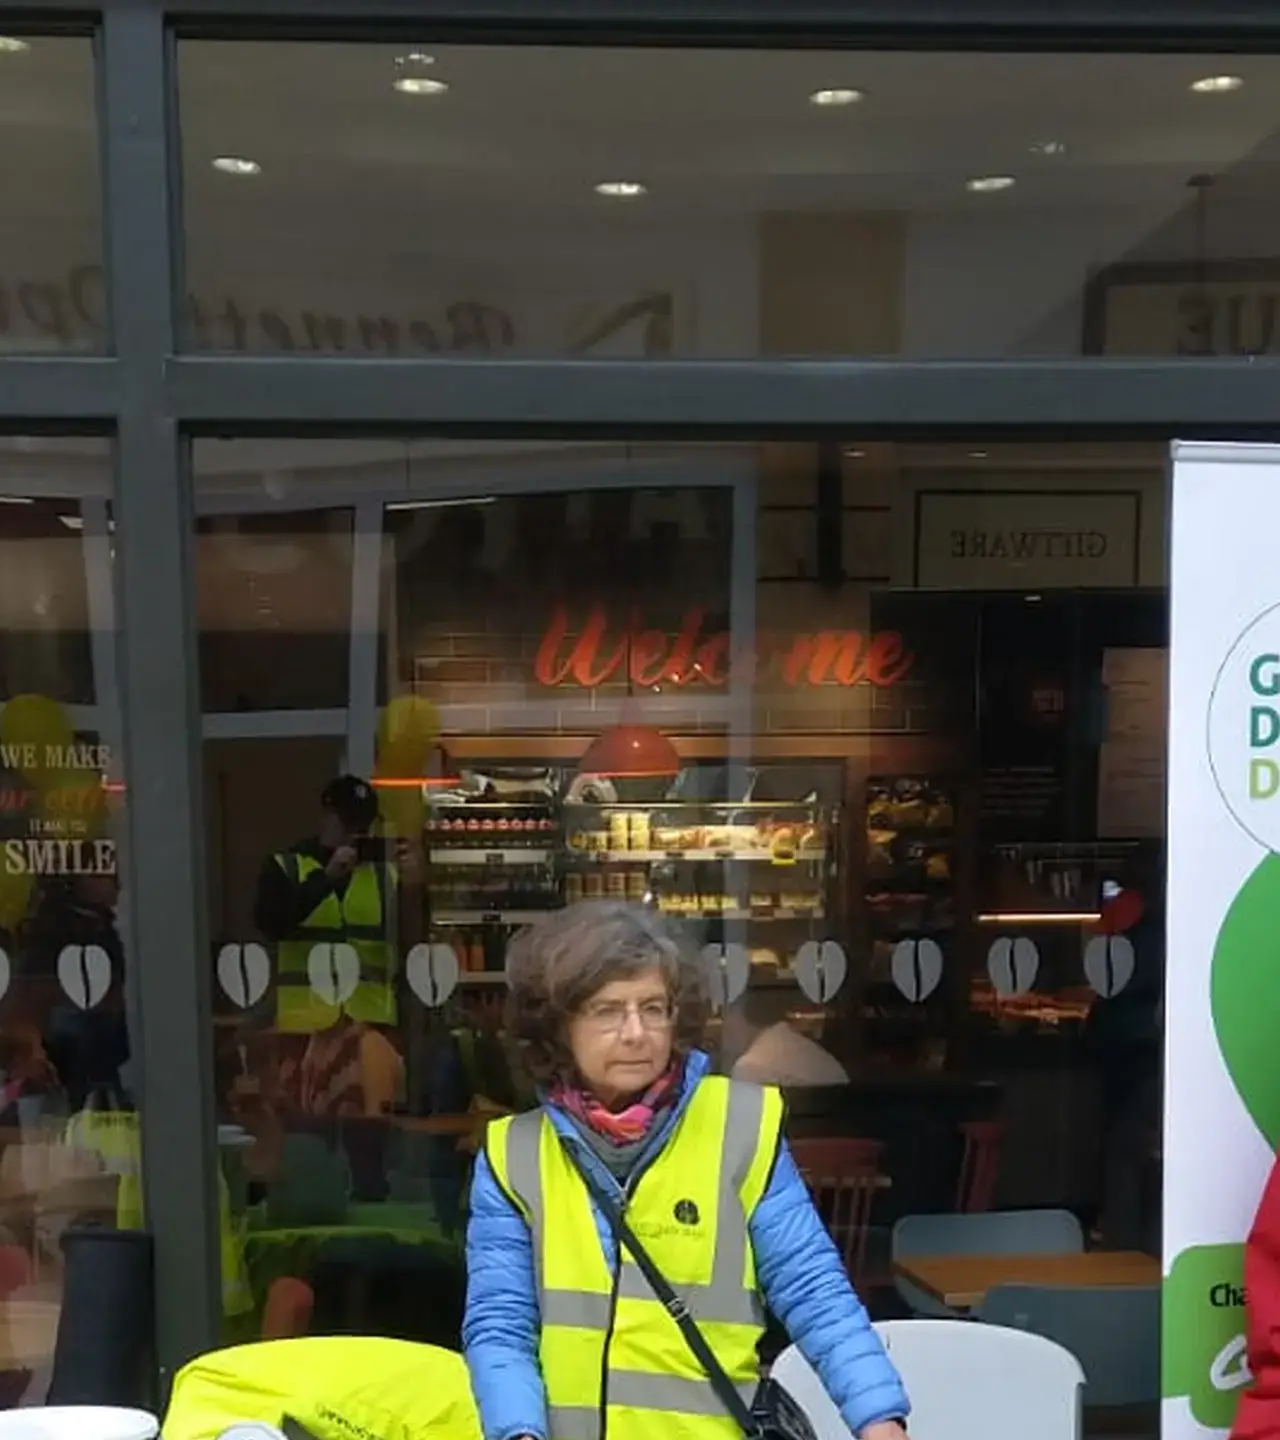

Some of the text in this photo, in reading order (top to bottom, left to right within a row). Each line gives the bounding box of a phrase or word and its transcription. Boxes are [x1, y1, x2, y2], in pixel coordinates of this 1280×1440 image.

[0, 743, 112, 769] WE MAKE
[4, 838, 117, 876] SMILE
